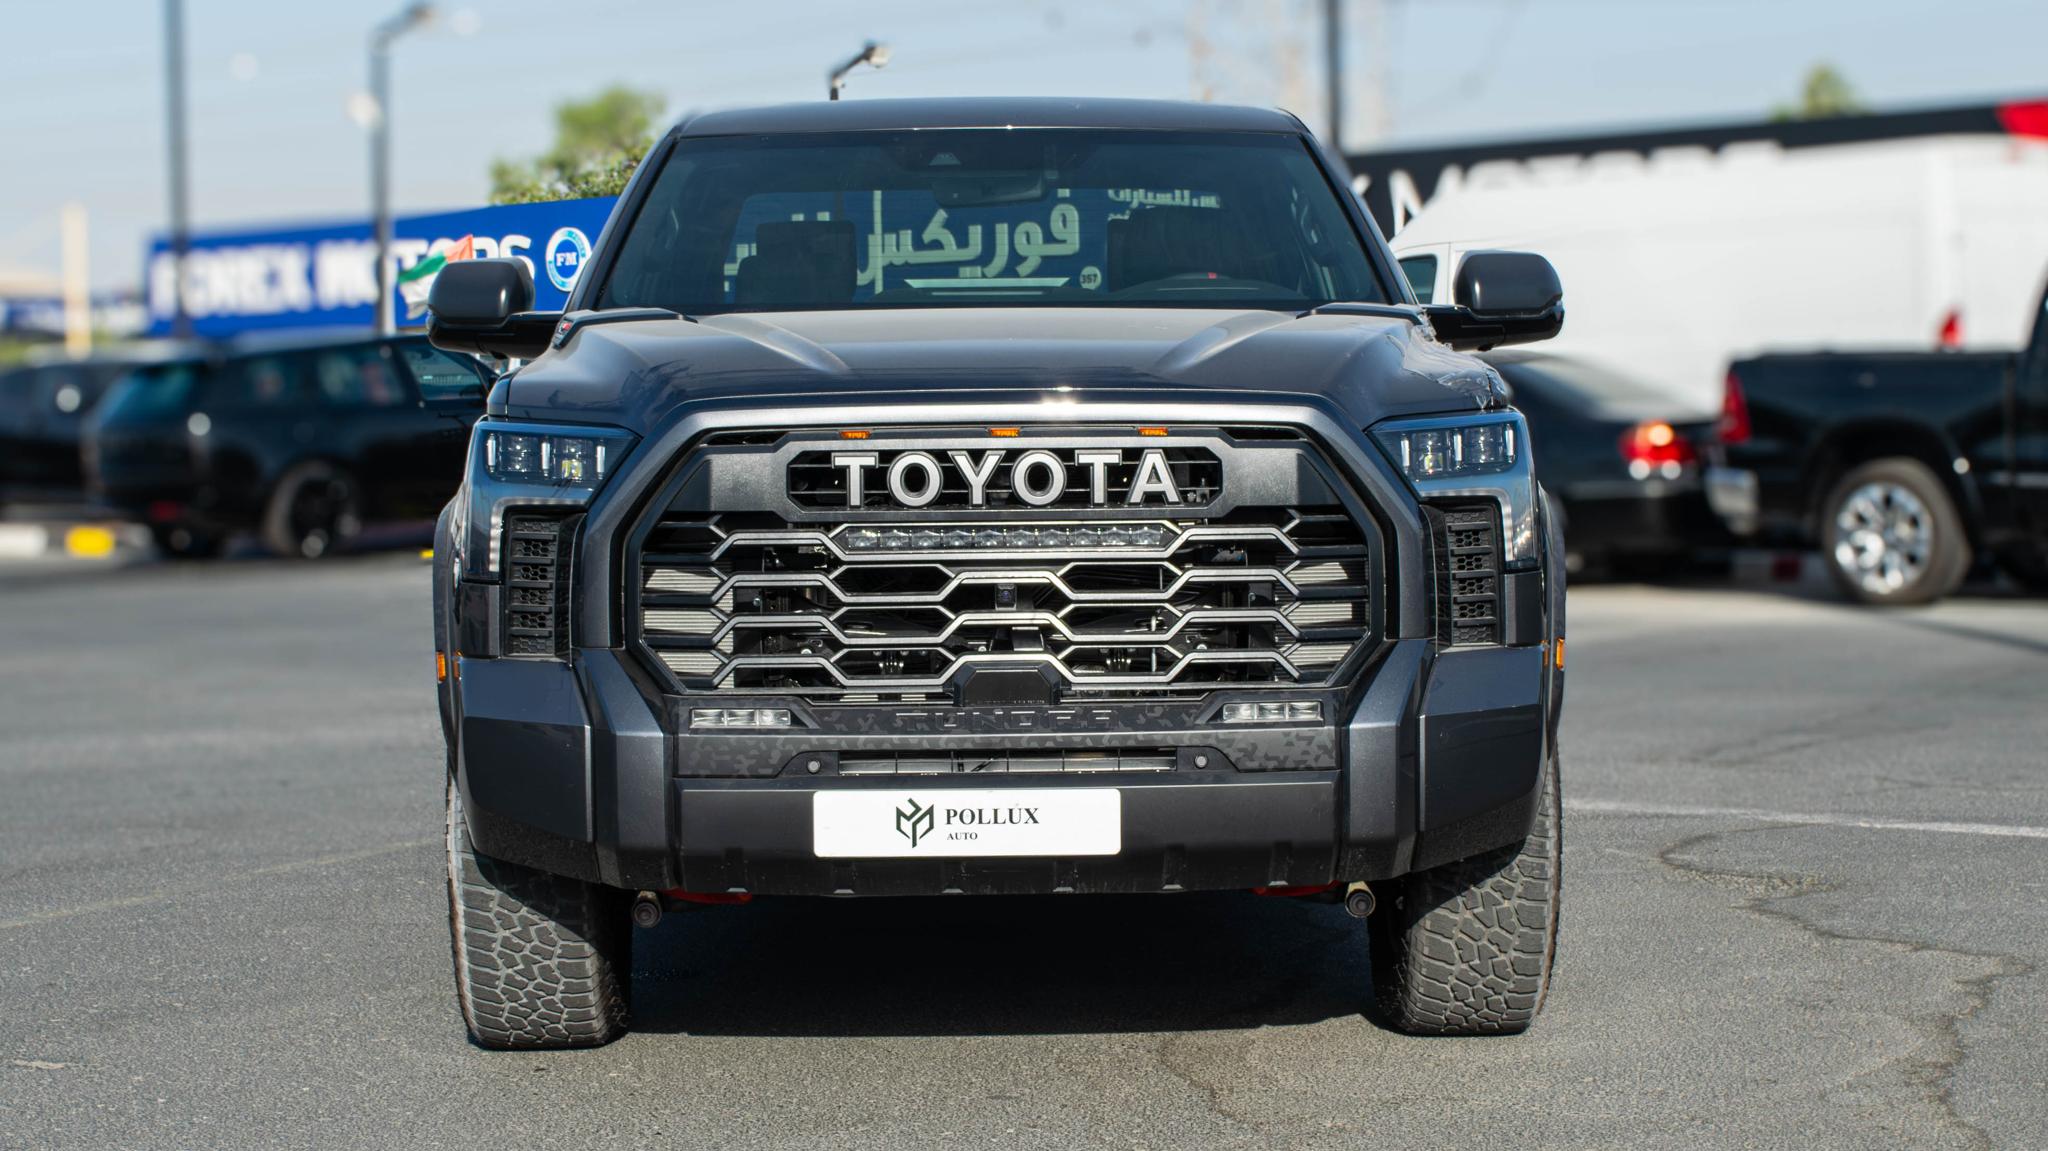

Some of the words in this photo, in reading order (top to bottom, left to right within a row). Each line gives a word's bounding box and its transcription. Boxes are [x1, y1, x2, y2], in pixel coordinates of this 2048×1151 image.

[556, 252, 577, 266] FM
[315, 234, 535, 310] MOTS
[831, 449, 1185, 508] TOYOTA
[945, 807, 1040, 825] POLLUX
[946, 832, 978, 840] AUTO
